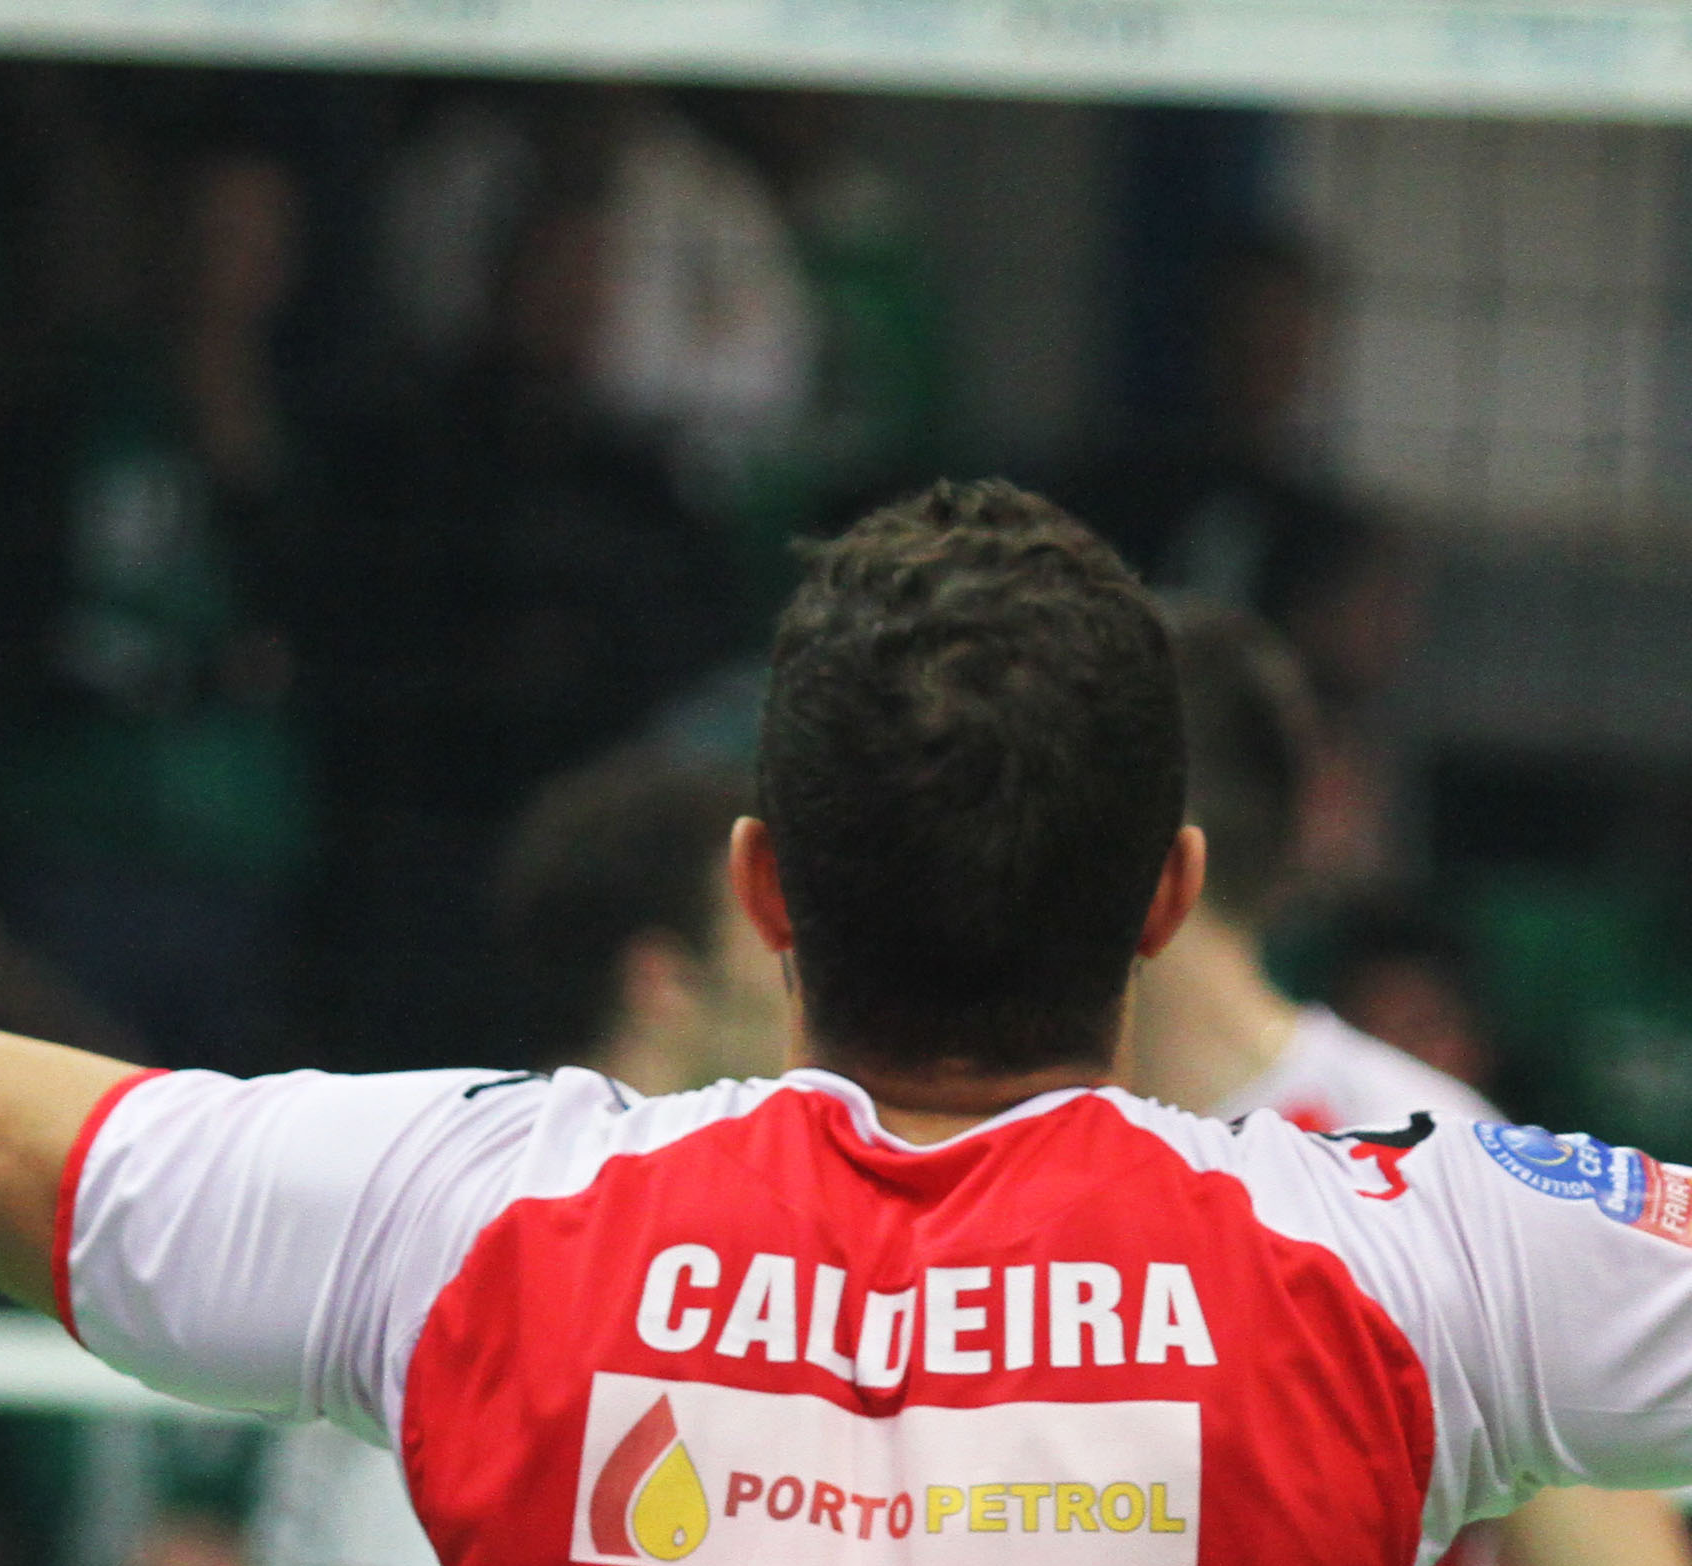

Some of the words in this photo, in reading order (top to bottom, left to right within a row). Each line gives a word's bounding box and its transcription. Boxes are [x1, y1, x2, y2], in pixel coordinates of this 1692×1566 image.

[636, 1243, 1218, 1390] CALDEIRA
[724, 1471, 914, 1540] PORTO
[925, 1482, 1186, 1534] PETROL
